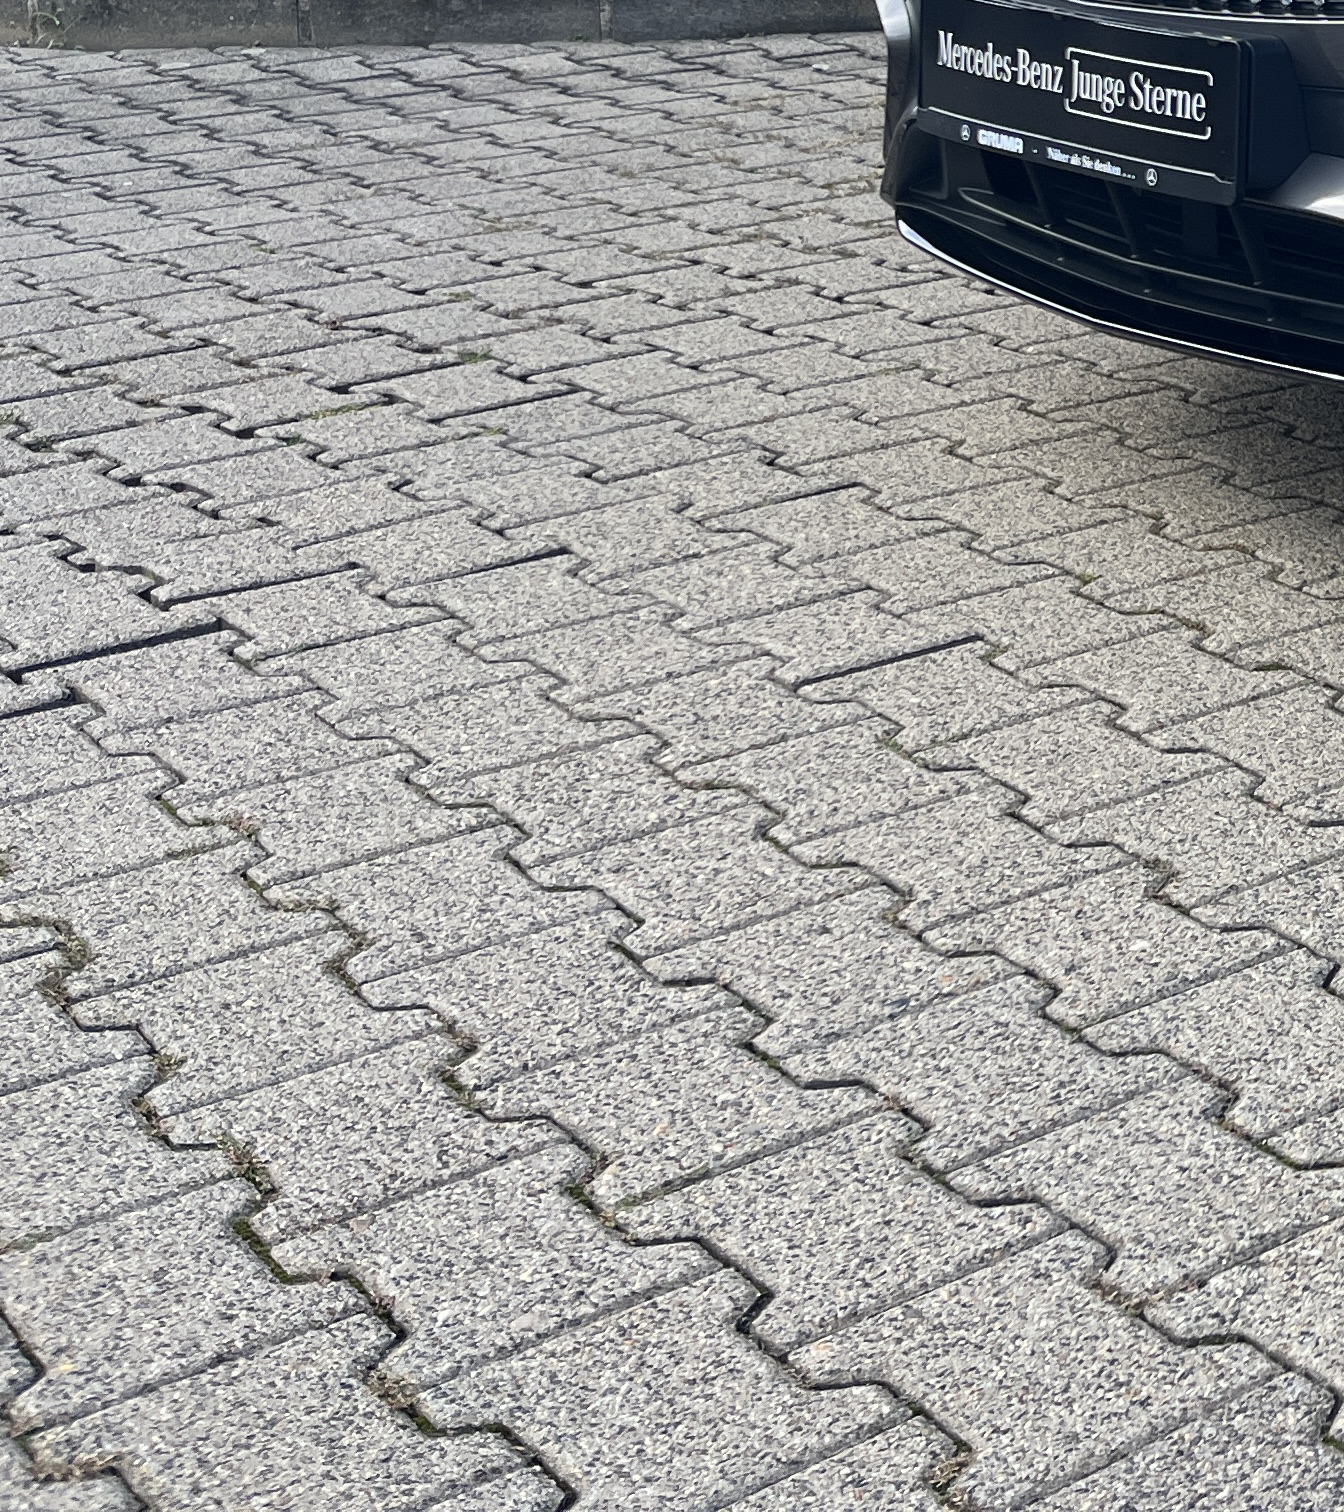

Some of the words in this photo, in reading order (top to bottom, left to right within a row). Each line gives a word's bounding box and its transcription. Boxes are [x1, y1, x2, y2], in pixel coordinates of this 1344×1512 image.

[936, 30, 1064, 94] Mercedes-Benz
[1070, 59, 1125, 113] Junge
[1128, 70, 1206, 122] Sterne
